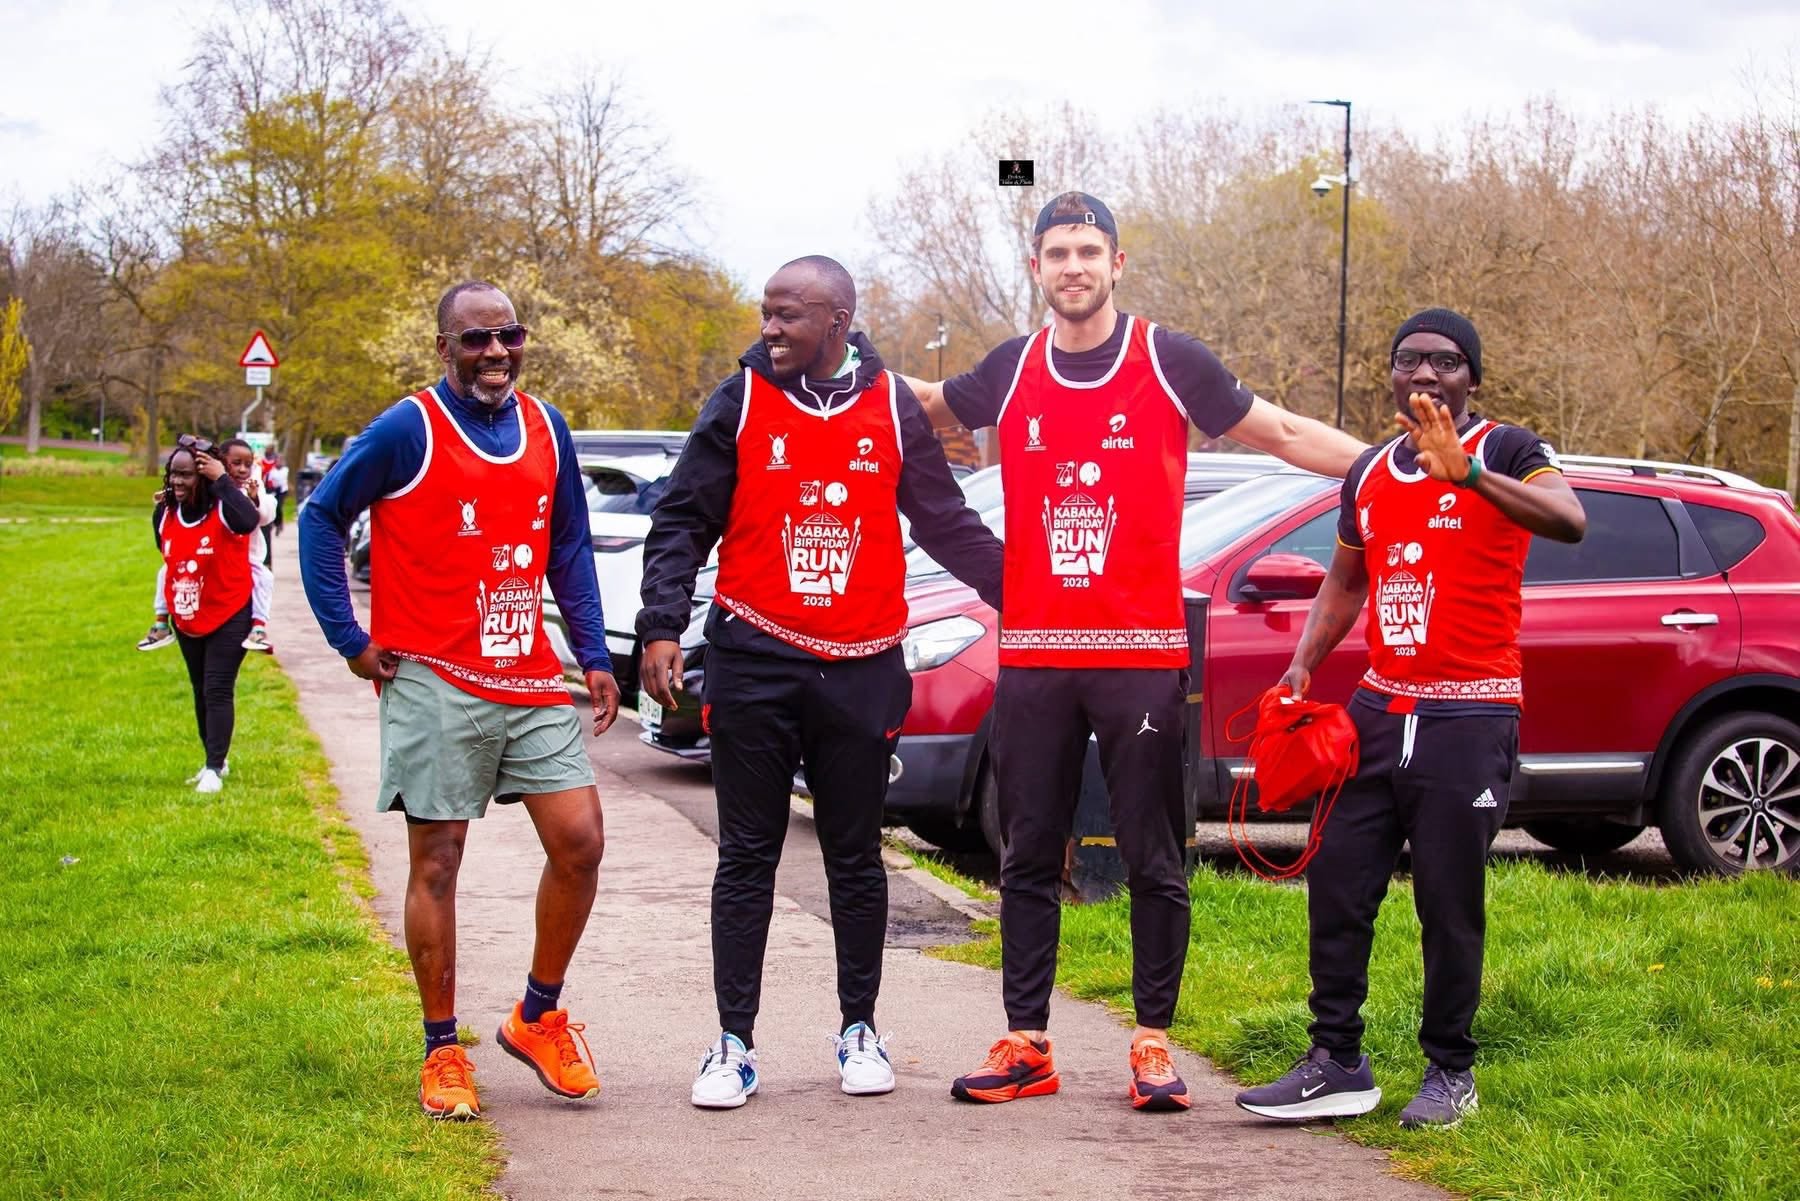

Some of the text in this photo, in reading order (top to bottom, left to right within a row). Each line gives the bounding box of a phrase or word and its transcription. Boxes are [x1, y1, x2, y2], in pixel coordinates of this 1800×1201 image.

[1101, 436, 1135, 449] airtel
[849, 458, 880, 473] airtel
[1053, 507, 1104, 518] KABAKA
[1053, 518, 1104, 529] BIRTHDAY
[1427, 515, 1462, 529] airtel
[794, 525, 850, 538] KABAKA
[794, 537, 850, 549] BIRTHDAY
[1051, 529, 1105, 552] RUN
[792, 548, 851, 572] RUN
[1063, 577, 1090, 588] 2026
[1382, 582, 1423, 594] KABAKA
[490, 589, 534, 603] KABAKA
[803, 595, 832, 607] 2026
[1381, 593, 1423, 604] BIRTHDAY
[489, 601, 534, 613] BIRTHDAY
[1380, 603, 1425, 625] RUN
[484, 611, 534, 635] RUN
[1472, 800, 1497, 808] adidas
